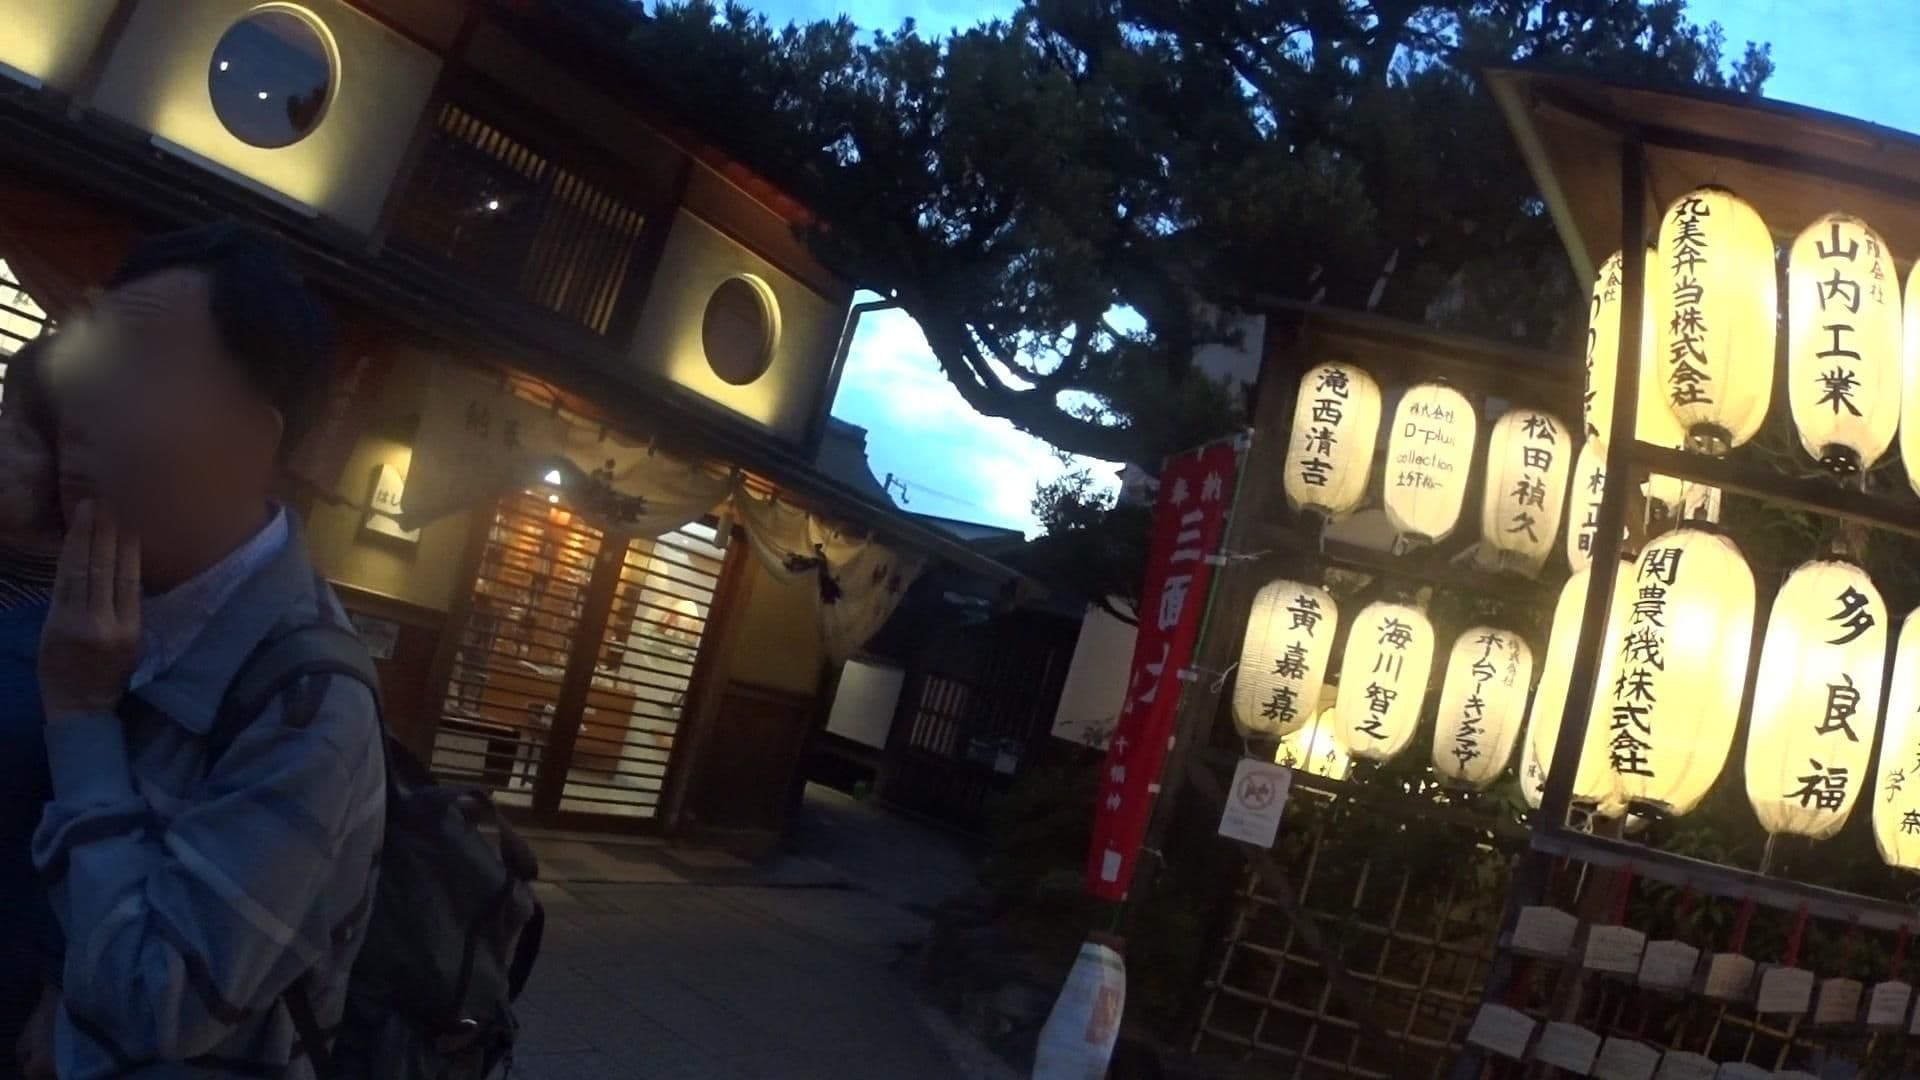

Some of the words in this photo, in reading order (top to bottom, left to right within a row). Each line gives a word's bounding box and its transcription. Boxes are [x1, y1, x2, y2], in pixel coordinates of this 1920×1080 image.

[1668, 197, 1713, 407] 丸美弁当株式会社
[1814, 223, 1863, 418] 山内工業
[1300, 366, 1349, 487] 滝西清吉
[1396, 450, 1453, 472] collection
[1354, 616, 1414, 740] 海川智之
[1609, 547, 1684, 778] 関農機株式会社
[1784, 585, 1876, 813] 多良福
